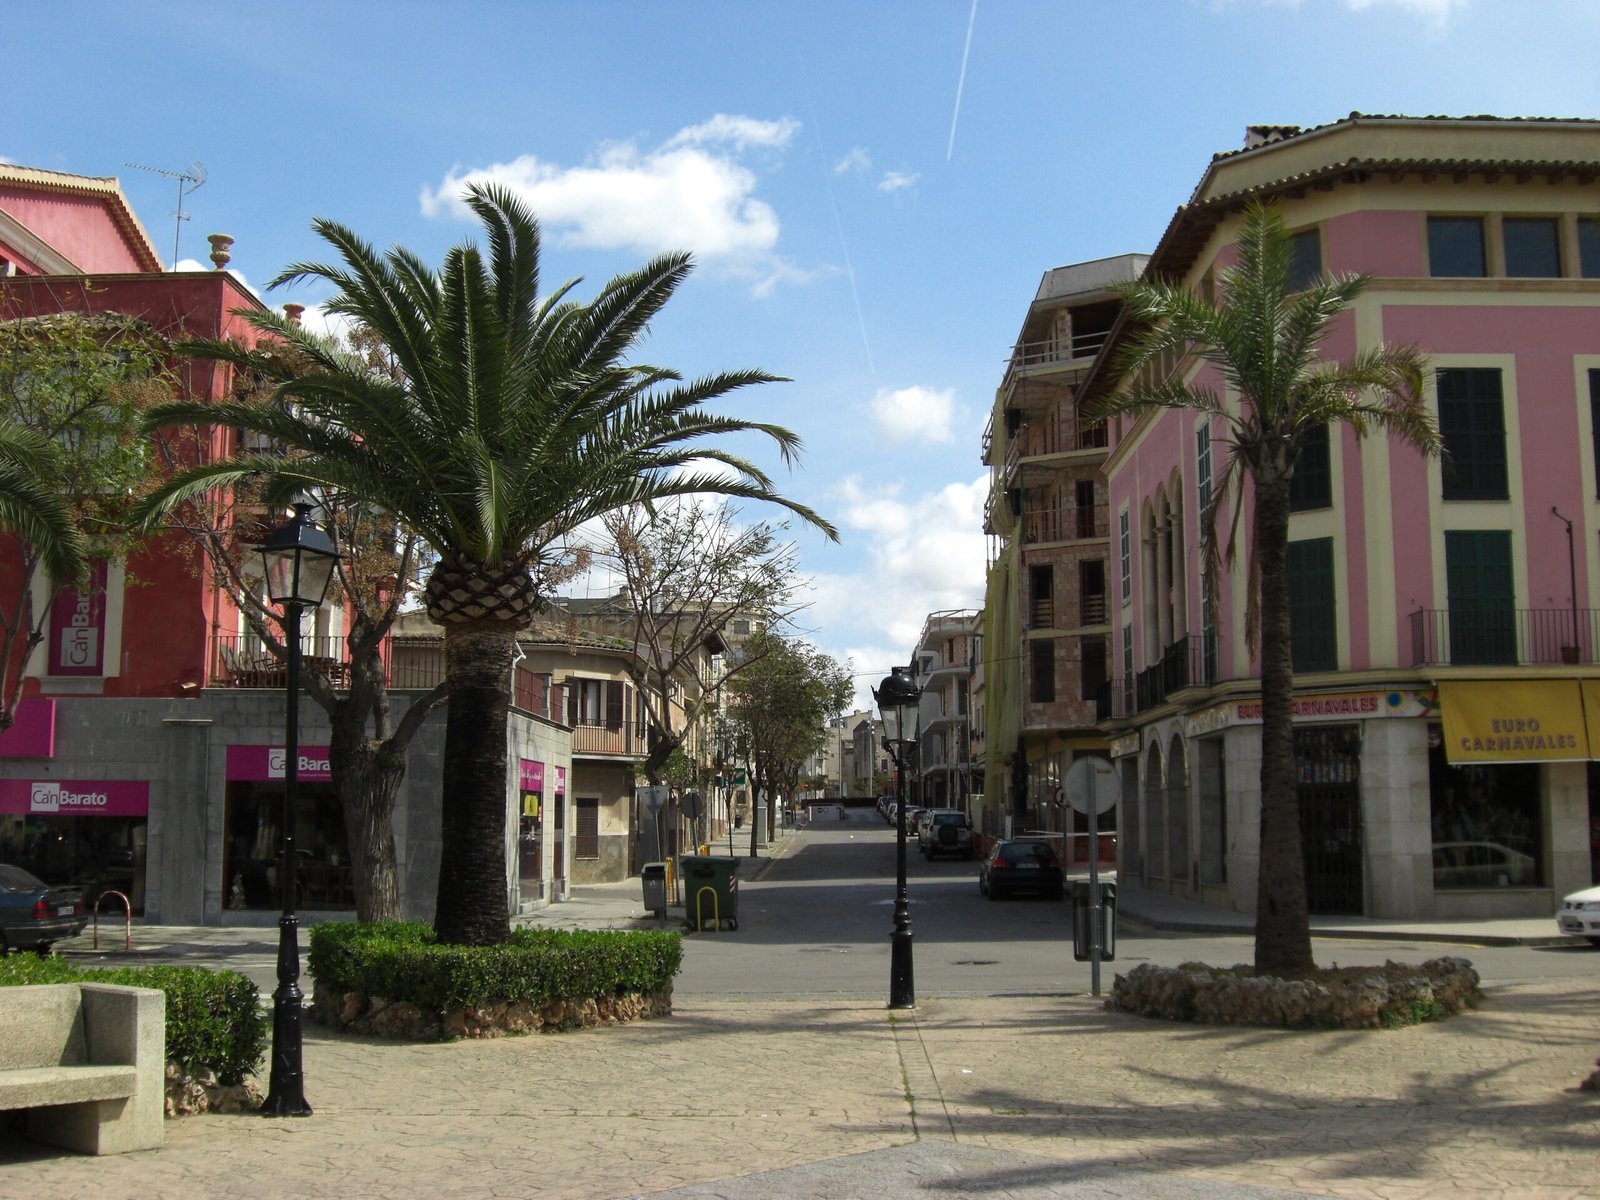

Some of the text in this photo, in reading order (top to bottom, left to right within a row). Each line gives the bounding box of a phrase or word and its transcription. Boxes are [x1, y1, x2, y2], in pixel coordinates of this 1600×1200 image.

[1237, 696, 1379, 720] EUR ARNAVALES
[1491, 719, 1540, 734] EURO
[1461, 735, 1577, 752] CARNAVALES
[298, 756, 331, 771] Bara
[59, 790, 107, 806] Barato
